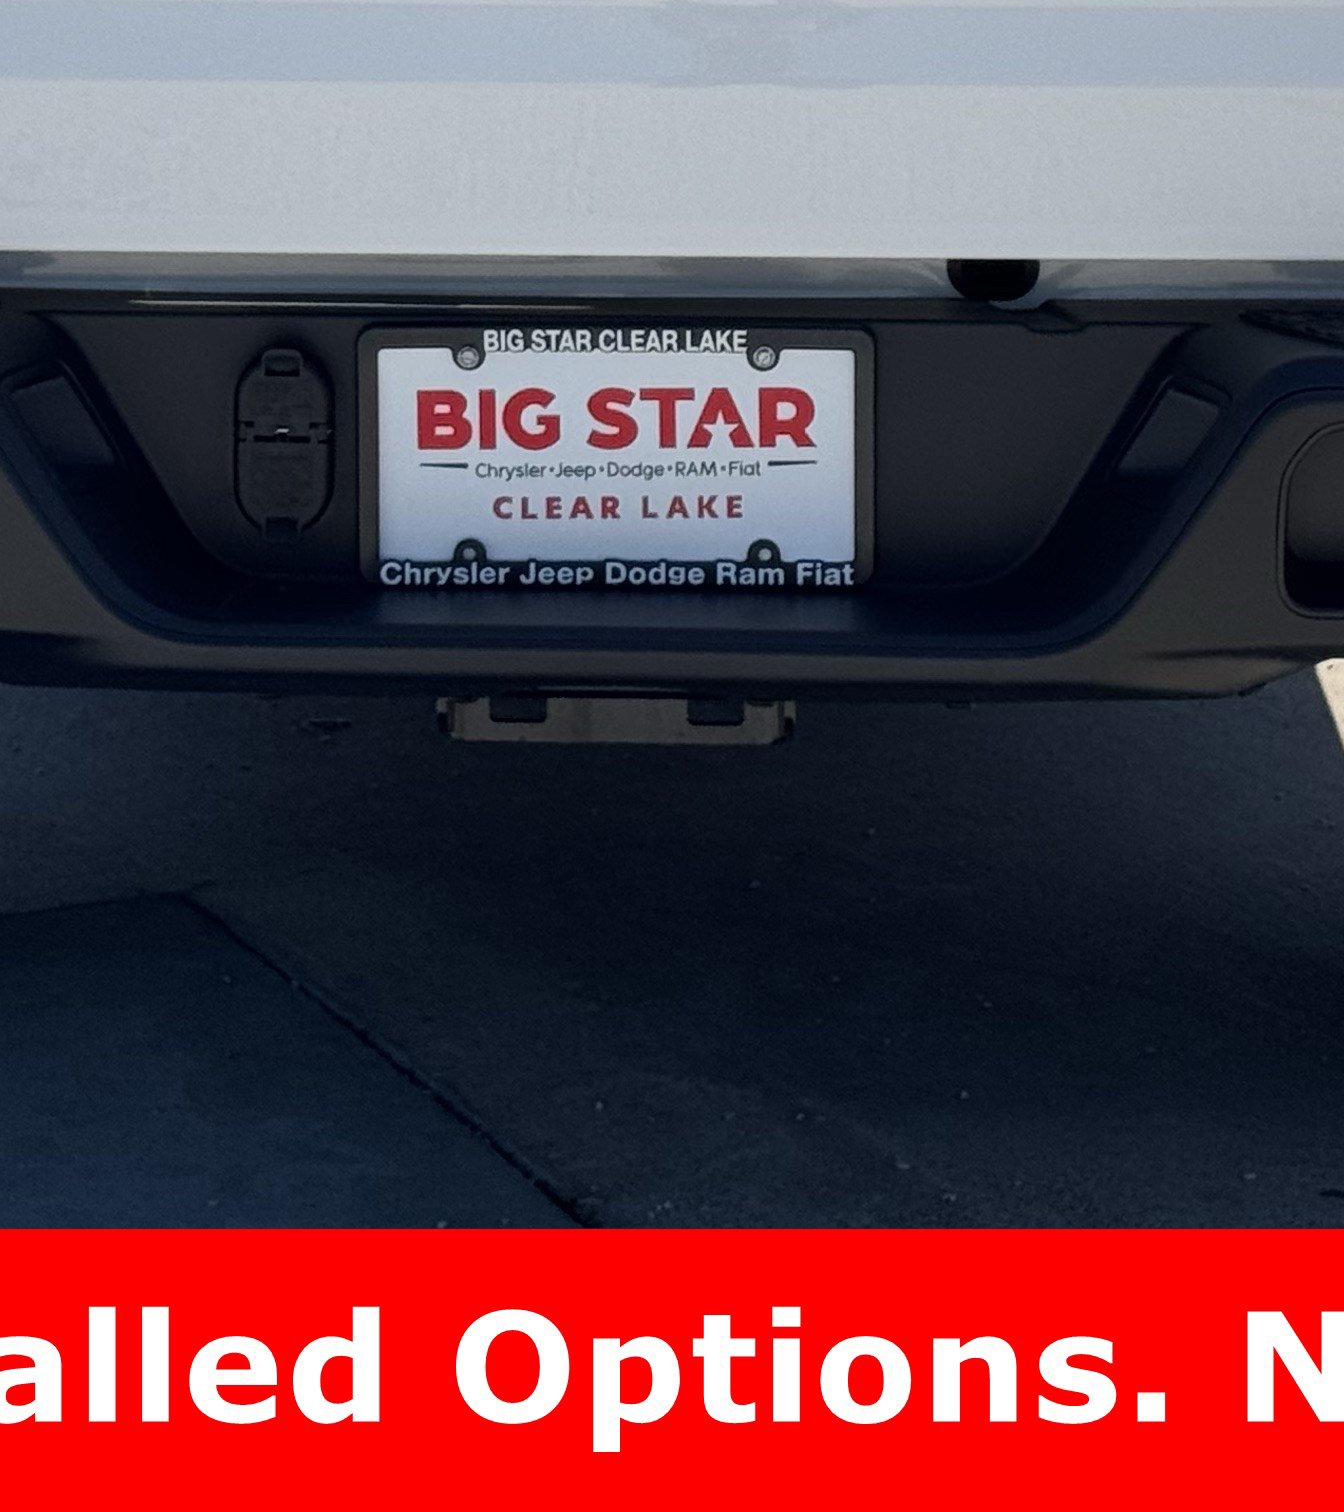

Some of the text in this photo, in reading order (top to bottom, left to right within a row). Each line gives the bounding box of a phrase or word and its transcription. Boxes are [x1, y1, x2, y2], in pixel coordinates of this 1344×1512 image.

[483, 329, 749, 353] BIG STAR CLEAR LAKE
[416, 387, 817, 451] BIG STAR
[492, 494, 744, 520] CLEAR LAKE
[379, 561, 855, 587] Chrysler Jeep Dodge Ram Fiat
